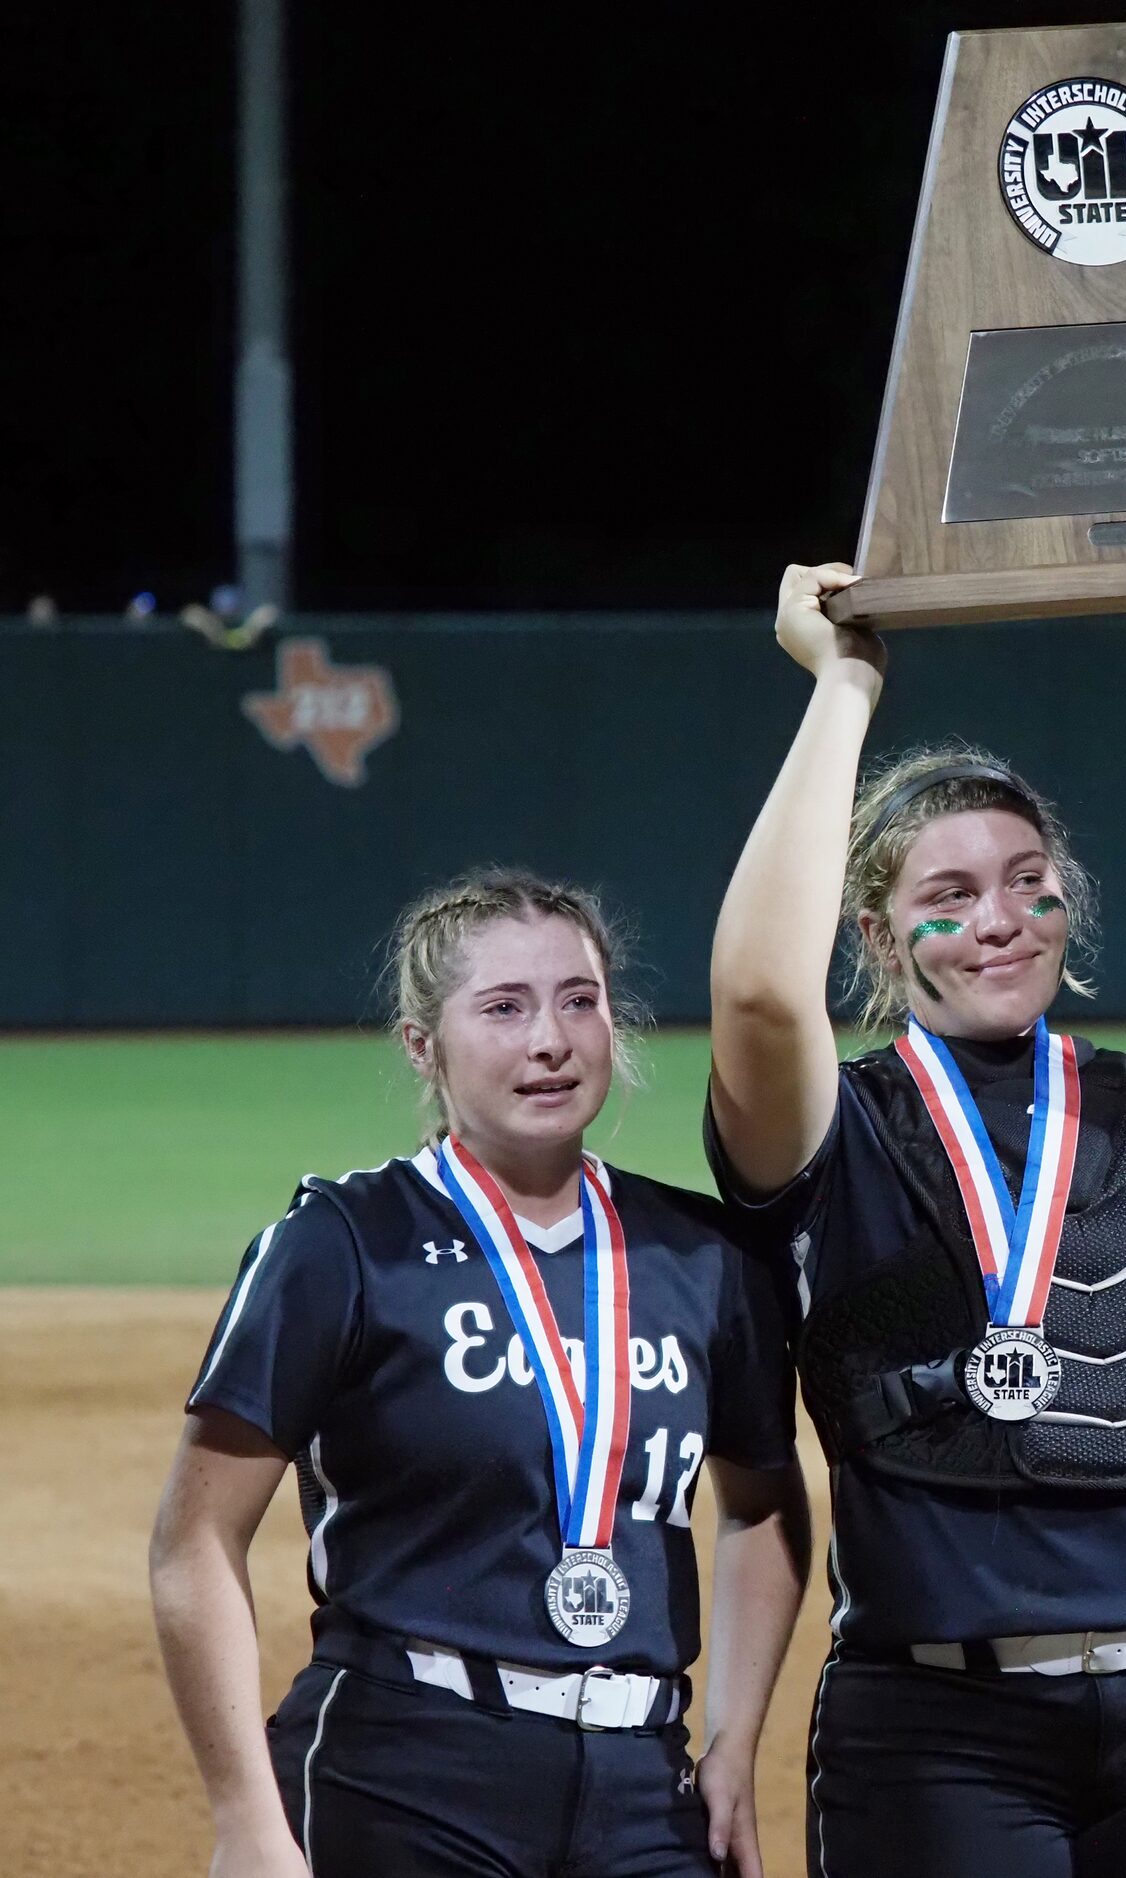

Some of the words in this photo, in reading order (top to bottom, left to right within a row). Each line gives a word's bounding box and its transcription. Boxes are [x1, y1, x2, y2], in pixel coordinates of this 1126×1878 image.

[1003, 138, 1058, 247] UNIVERSITY
[443, 1301, 689, 1403] Eages
[965, 1356, 991, 1411] UNIVERSITY
[979, 1330, 1057, 1366] INTERSCHOLASTIC
[1033, 1373, 1060, 1409] LEAGUE
[984, 1353, 1042, 1388] UIL
[993, 1389, 1030, 1400] STATE
[631, 1427, 704, 1528] 12
[561, 1576, 614, 1613] UIL
[572, 1614, 605, 1626] STATE
[608, 1599, 628, 1635] LEAGUE
